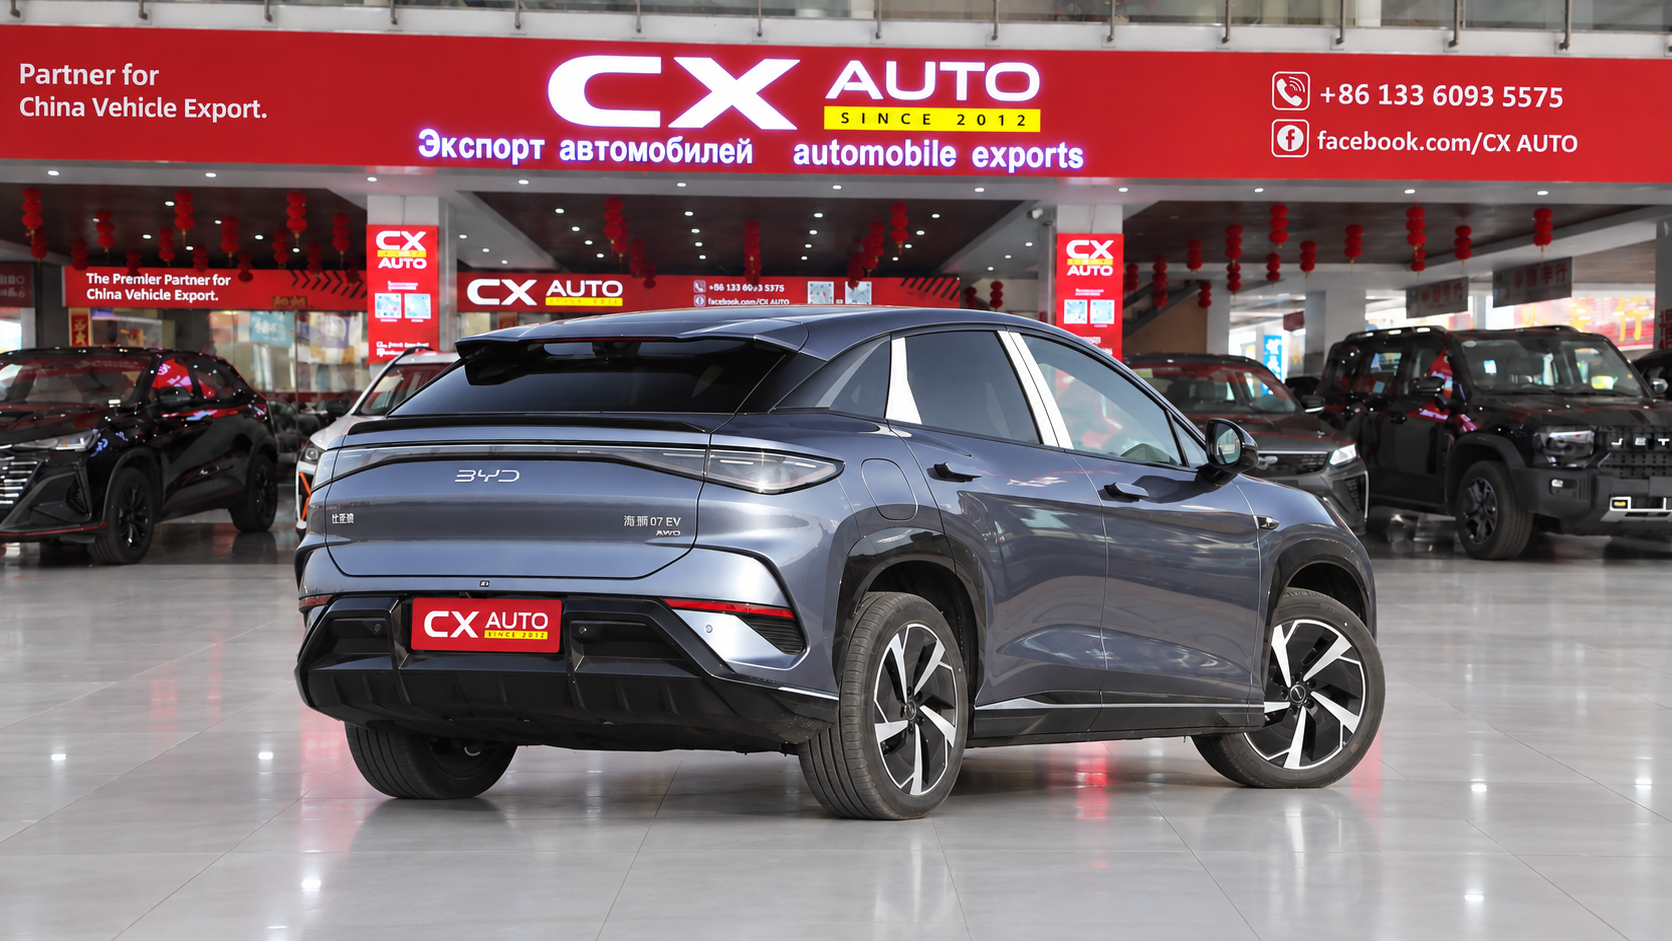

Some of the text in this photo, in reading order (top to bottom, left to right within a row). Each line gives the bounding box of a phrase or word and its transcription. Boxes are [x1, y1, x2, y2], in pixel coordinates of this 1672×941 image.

[20, 63, 159, 86] Partner for
[548, 55, 1040, 130] CX AUTO
[1320, 83, 1563, 108] +86 133 6093 5575
[19, 96, 267, 123] China Vehicle Export.
[841, 112, 1026, 127] SINCE 2012
[418, 128, 753, 165] Экспорт автомобилей
[1317, 131, 1578, 155] facebook.com/CX AUTO
[793, 139, 1084, 173] automobile exports
[376, 230, 427, 250] CX
[1066, 239, 1114, 259] CX
[378, 257, 427, 269] AUTO
[1067, 265, 1114, 276] AUTO
[86, 273, 109, 284] The
[164, 274, 210, 286] Partner
[212, 274, 231, 286] for
[726, 283, 741, 292] 133
[86, 288, 219, 303] China Vehicle Export.
[467, 278, 623, 305] CX AUTO
[455, 469, 520, 482] BYD
[650, 517, 663, 527] 07
[666, 517, 681, 527] EV
[424, 610, 549, 638] CX AUTO
